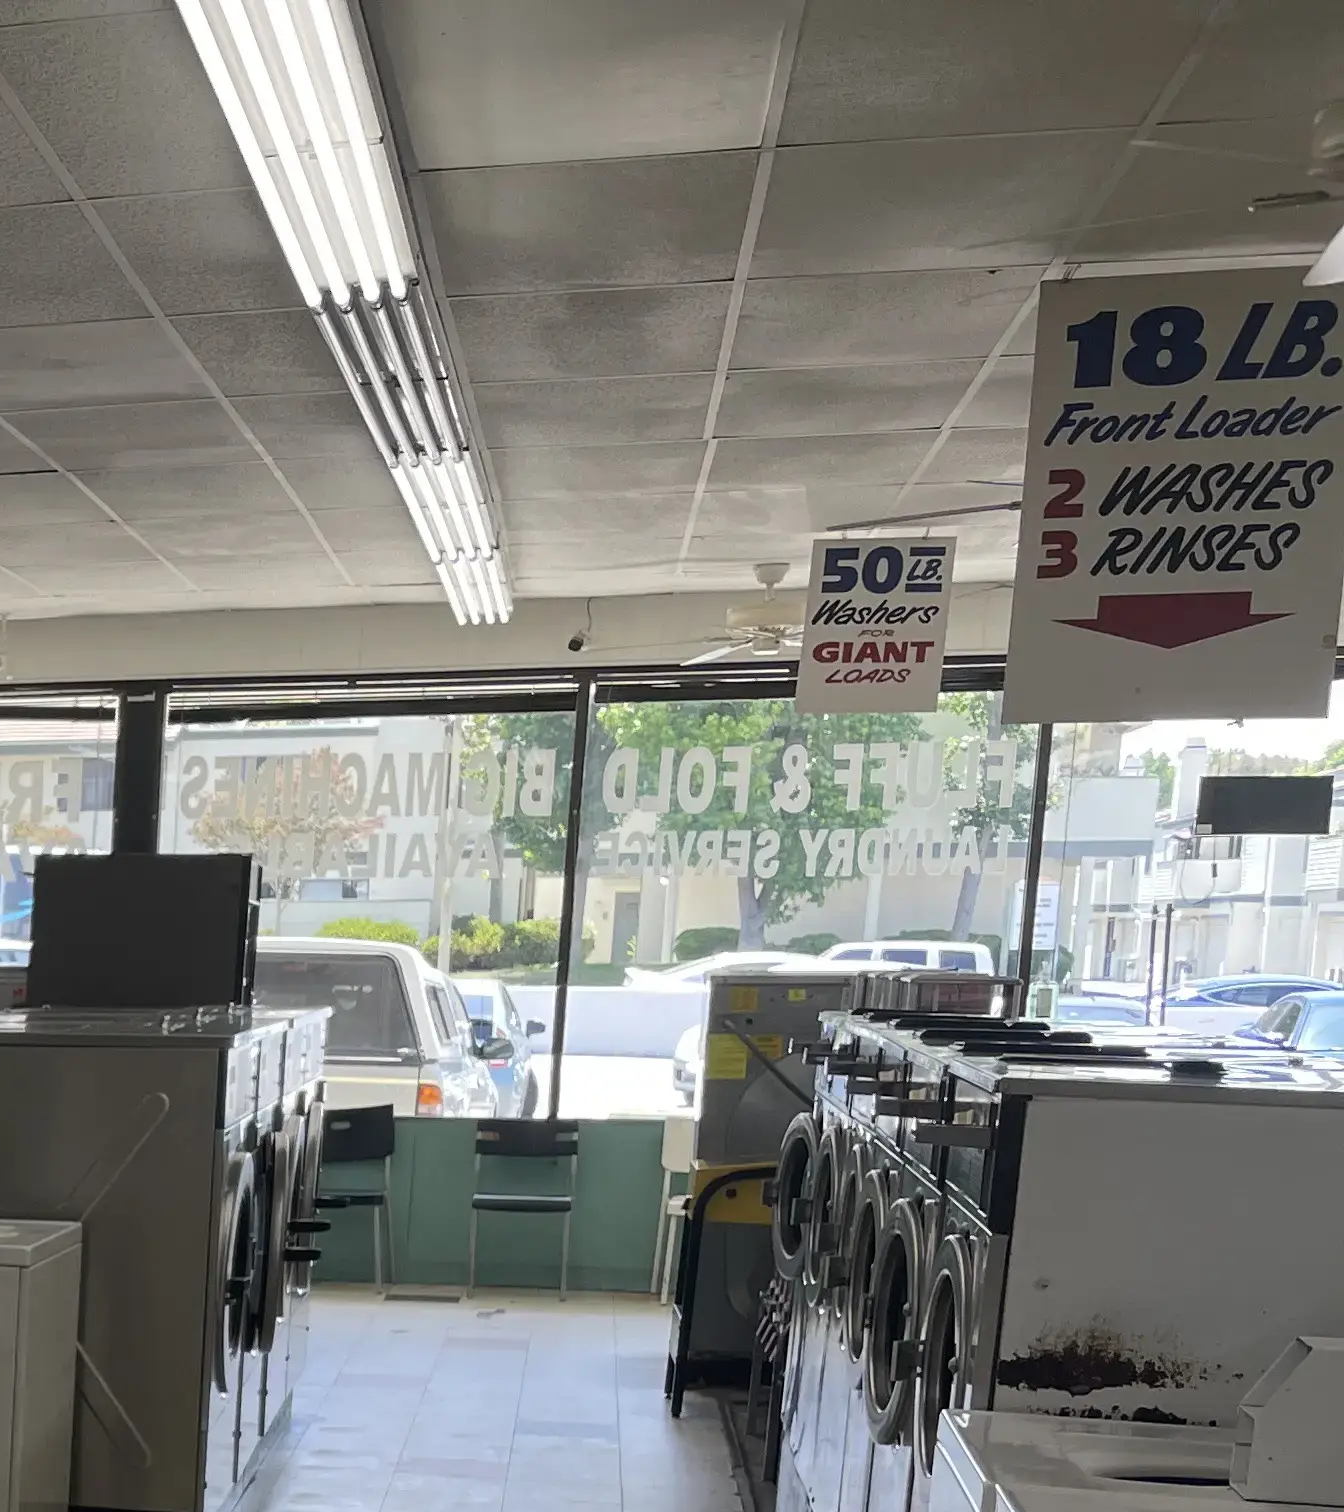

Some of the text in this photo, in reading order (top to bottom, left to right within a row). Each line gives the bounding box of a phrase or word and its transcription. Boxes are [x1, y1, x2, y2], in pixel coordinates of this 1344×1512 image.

[1067, 305, 1208, 388] 18
[1044, 394, 1344, 447] Front Loader
[1043, 459, 1333, 519] 2 WASHES
[821, 546, 943, 594] 50 LB.
[1037, 522, 1300, 579] 3 RINSES
[812, 599, 939, 627] Washers
[858, 628, 894, 638] FOR
[813, 641, 934, 664] GIANT
[825, 667, 911, 684] LOADS
